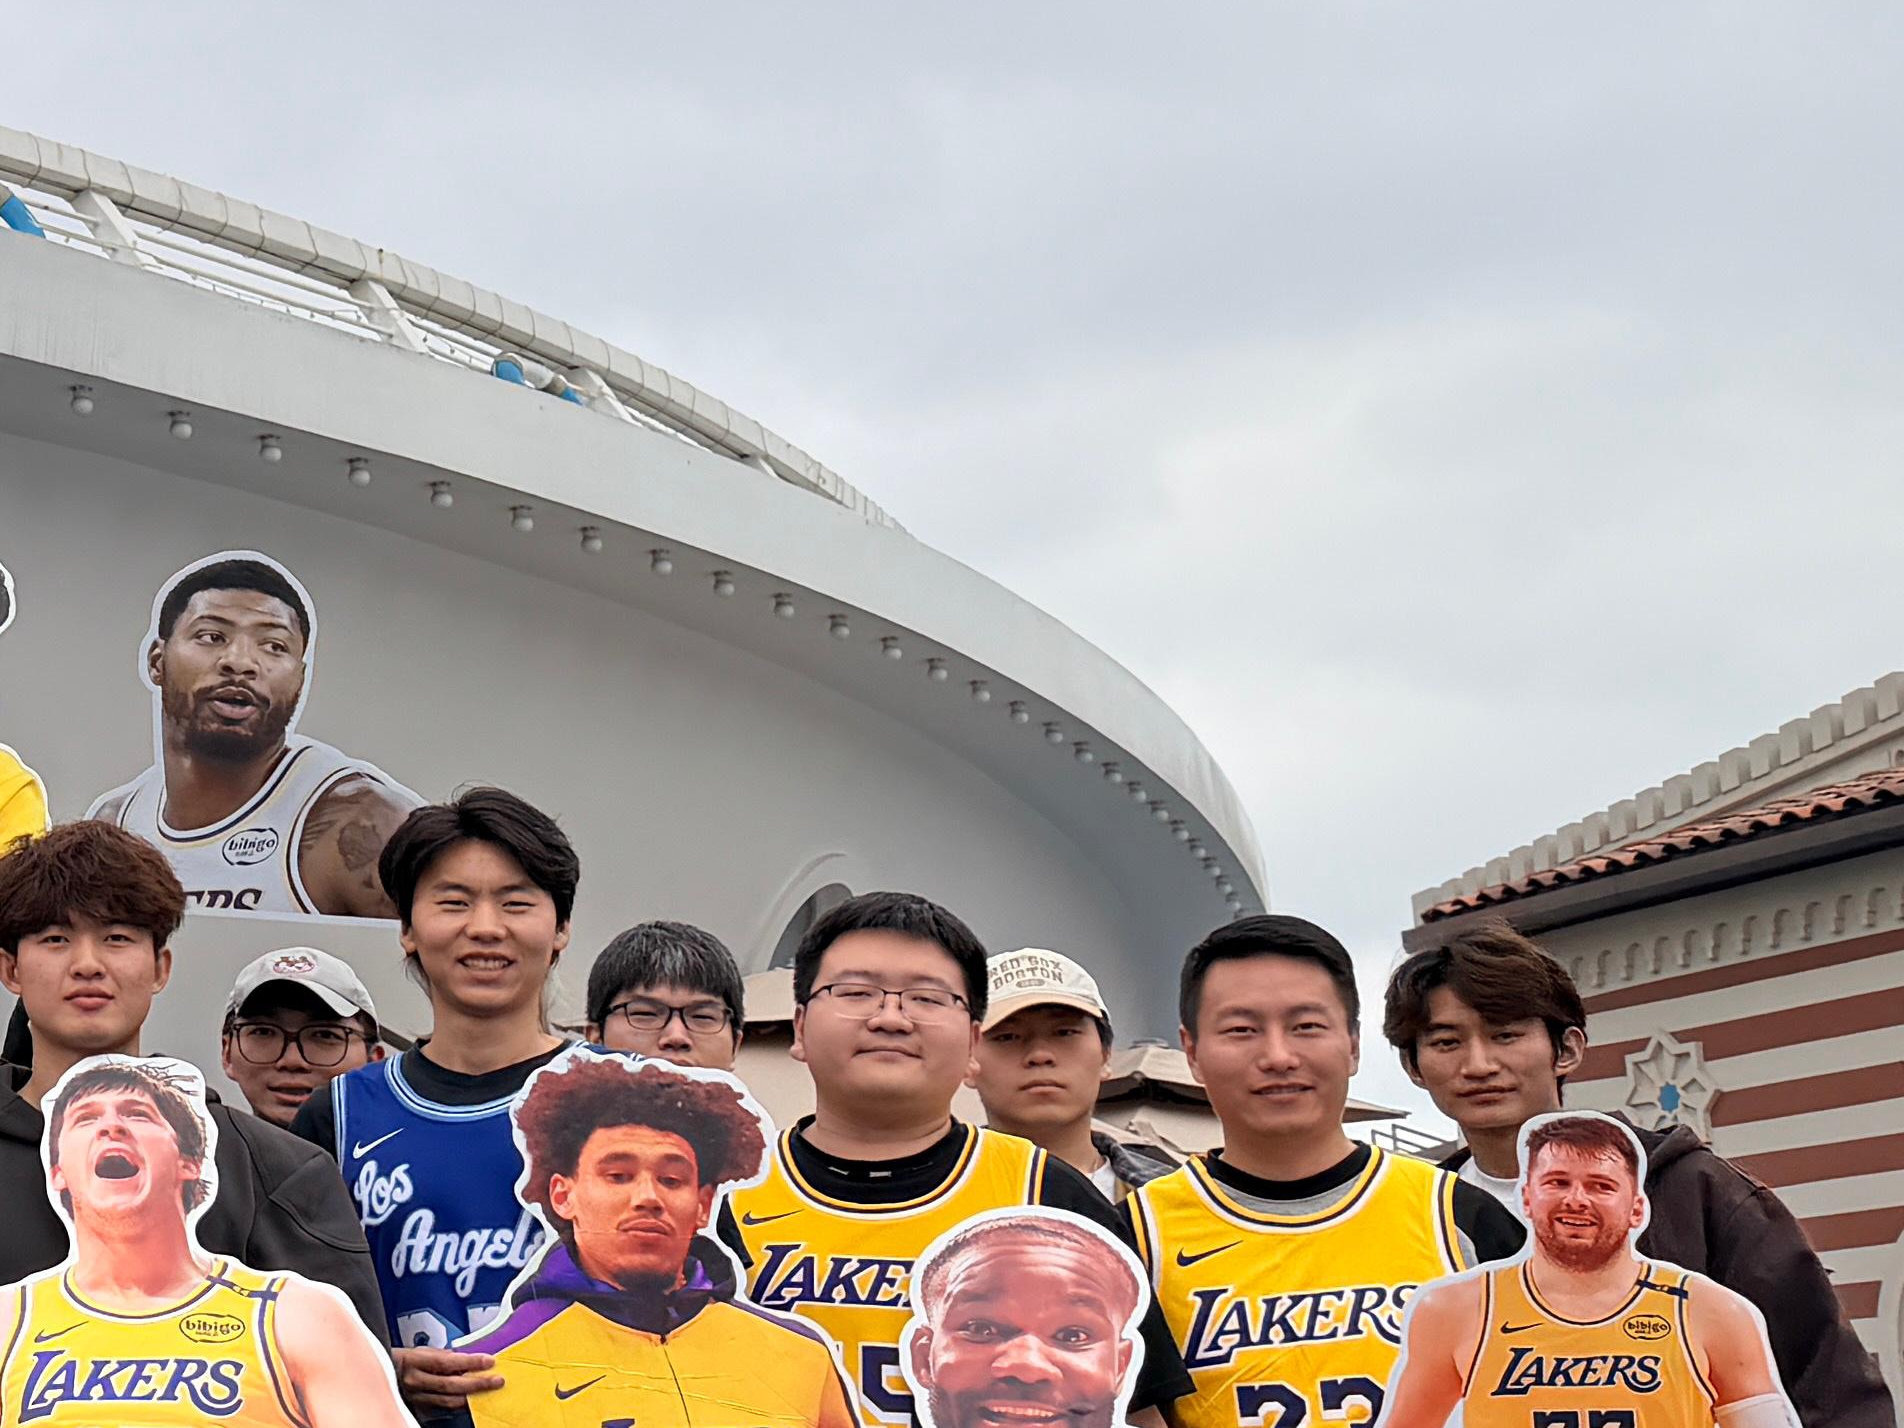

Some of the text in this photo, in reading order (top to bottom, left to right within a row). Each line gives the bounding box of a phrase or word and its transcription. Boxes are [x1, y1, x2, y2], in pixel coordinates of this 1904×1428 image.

[353, 1159, 414, 1233] Los
[391, 1208, 547, 1299] Angel
[749, 1243, 915, 1312] LAKE
[185, 1318, 242, 1335] bibigo
[1183, 1283, 1420, 1370] LAKERS
[18, 1350, 245, 1425] LAKERS
[1490, 1347, 1662, 1394] LAKERS
